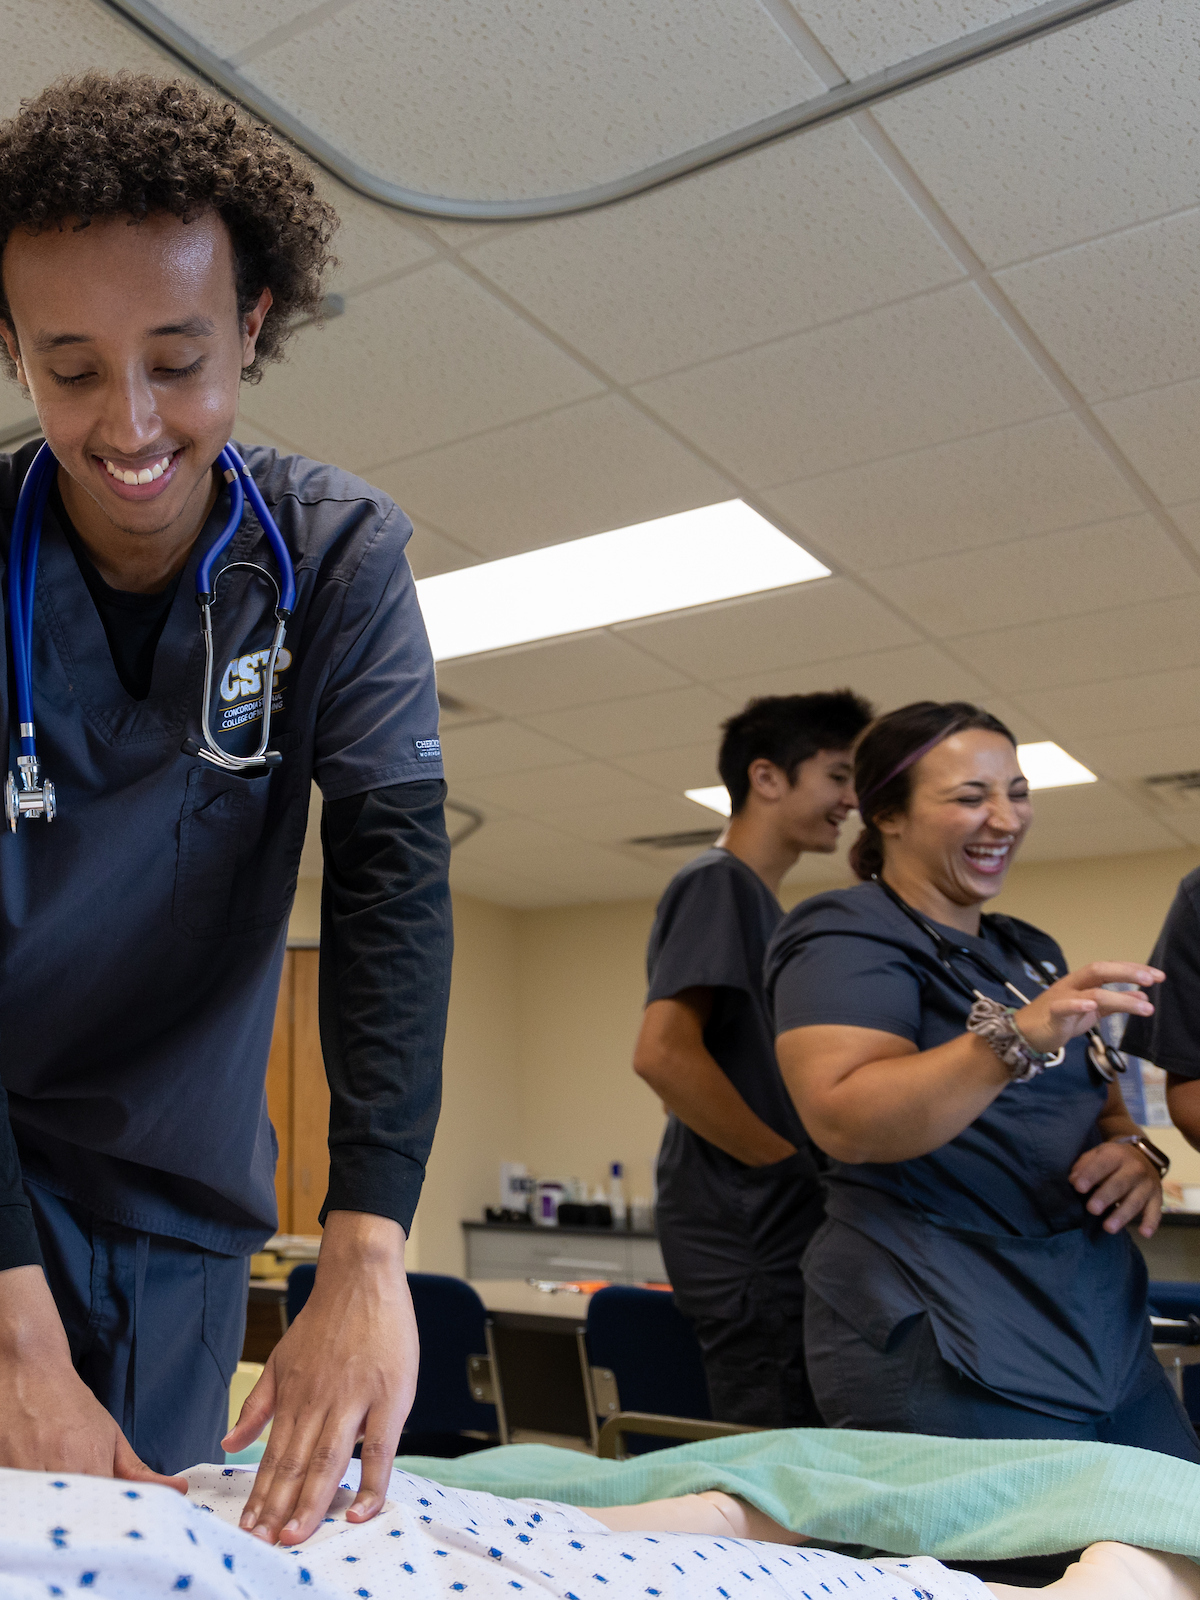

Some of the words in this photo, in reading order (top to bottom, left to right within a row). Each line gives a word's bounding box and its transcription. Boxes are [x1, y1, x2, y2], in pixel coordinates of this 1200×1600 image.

[223, 701, 258, 718] CONCORDIA
[221, 712, 248, 729] COLLEGE
[248, 710, 257, 720] OF
